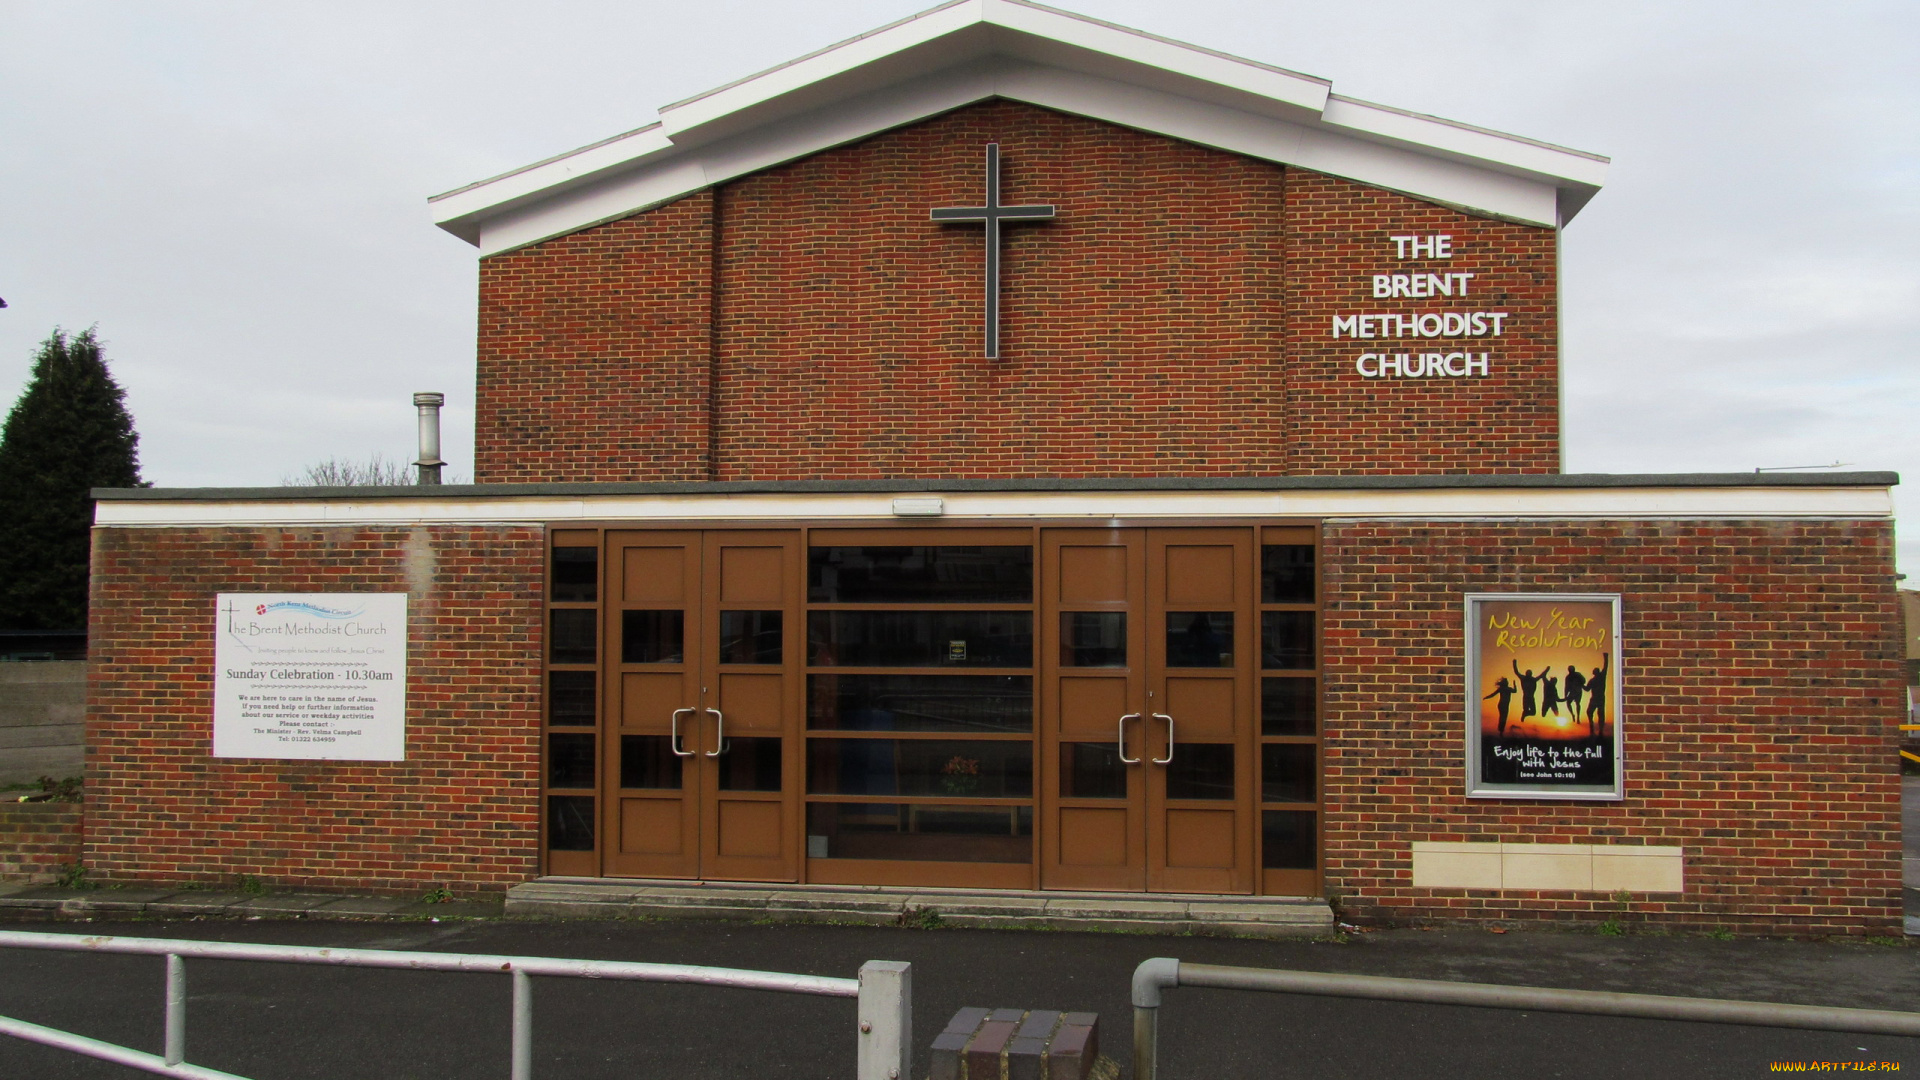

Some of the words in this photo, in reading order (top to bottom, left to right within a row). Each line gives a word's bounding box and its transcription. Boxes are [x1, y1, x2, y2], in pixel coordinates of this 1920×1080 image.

[1390, 235, 1452, 259] THE
[1373, 273, 1474, 298] BRENT
[1332, 312, 1508, 338] METHODIST
[1356, 352, 1488, 377] CHURCH
[302, 602, 331, 613] Methodist
[1489, 612, 1541, 630] New
[1547, 607, 1594, 630] Year
[249, 622, 283, 636] Brent
[285, 622, 342, 636] Methodist
[344, 622, 387, 636] Church
[1496, 628, 1606, 653] Resolution?
[278, 646, 296, 655] people
[348, 646, 366, 654] Jesus
[366, 646, 385, 654] Christ
[226, 669, 267, 681] Sunday
[270, 669, 334, 680] Celebration
[345, 670, 393, 680] 10.30am
[311, 712, 340, 720] weekday
[1493, 745, 1524, 761] Enjoy
[1526, 744, 1546, 758] life
[1548, 746, 1560, 758] to
[1562, 746, 1582, 758] the
[1584, 745, 1602, 758] full
[1522, 757, 1546, 768] with
[1550, 757, 1582, 768] Jesus
